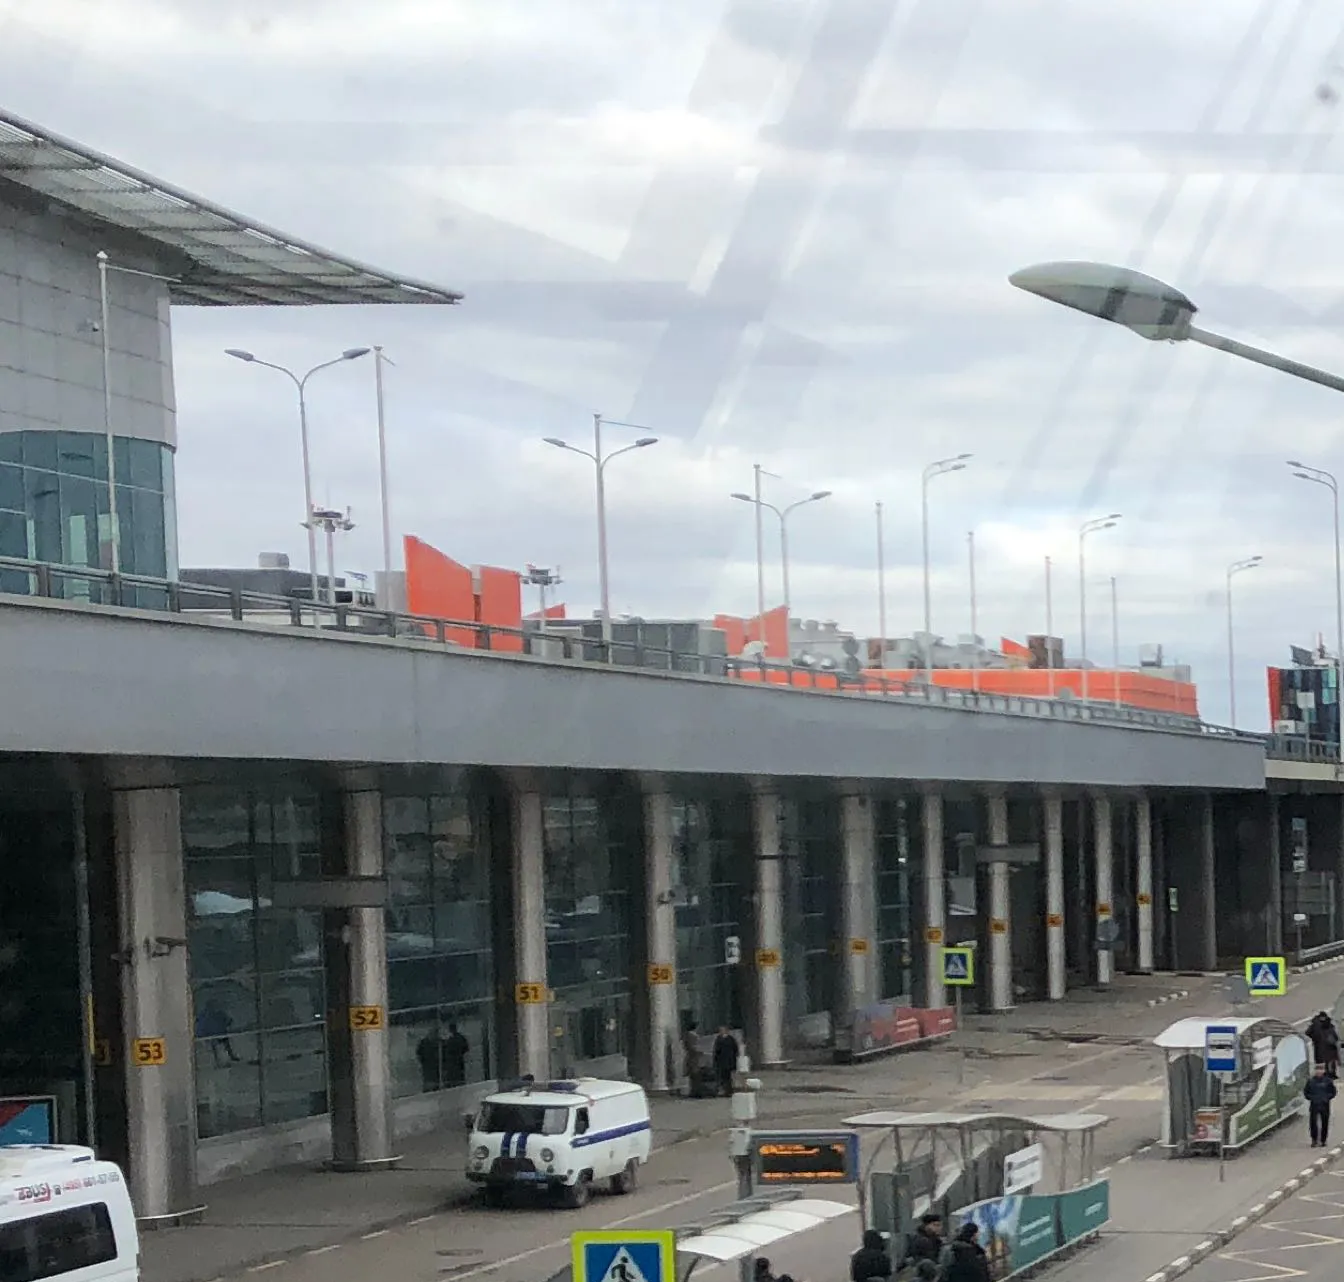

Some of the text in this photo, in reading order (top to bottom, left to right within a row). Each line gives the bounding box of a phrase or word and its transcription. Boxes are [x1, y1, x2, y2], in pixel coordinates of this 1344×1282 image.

[519, 986, 539, 1000] 51
[354, 1010, 379, 1027] 52
[138, 1042, 163, 1062] 53
